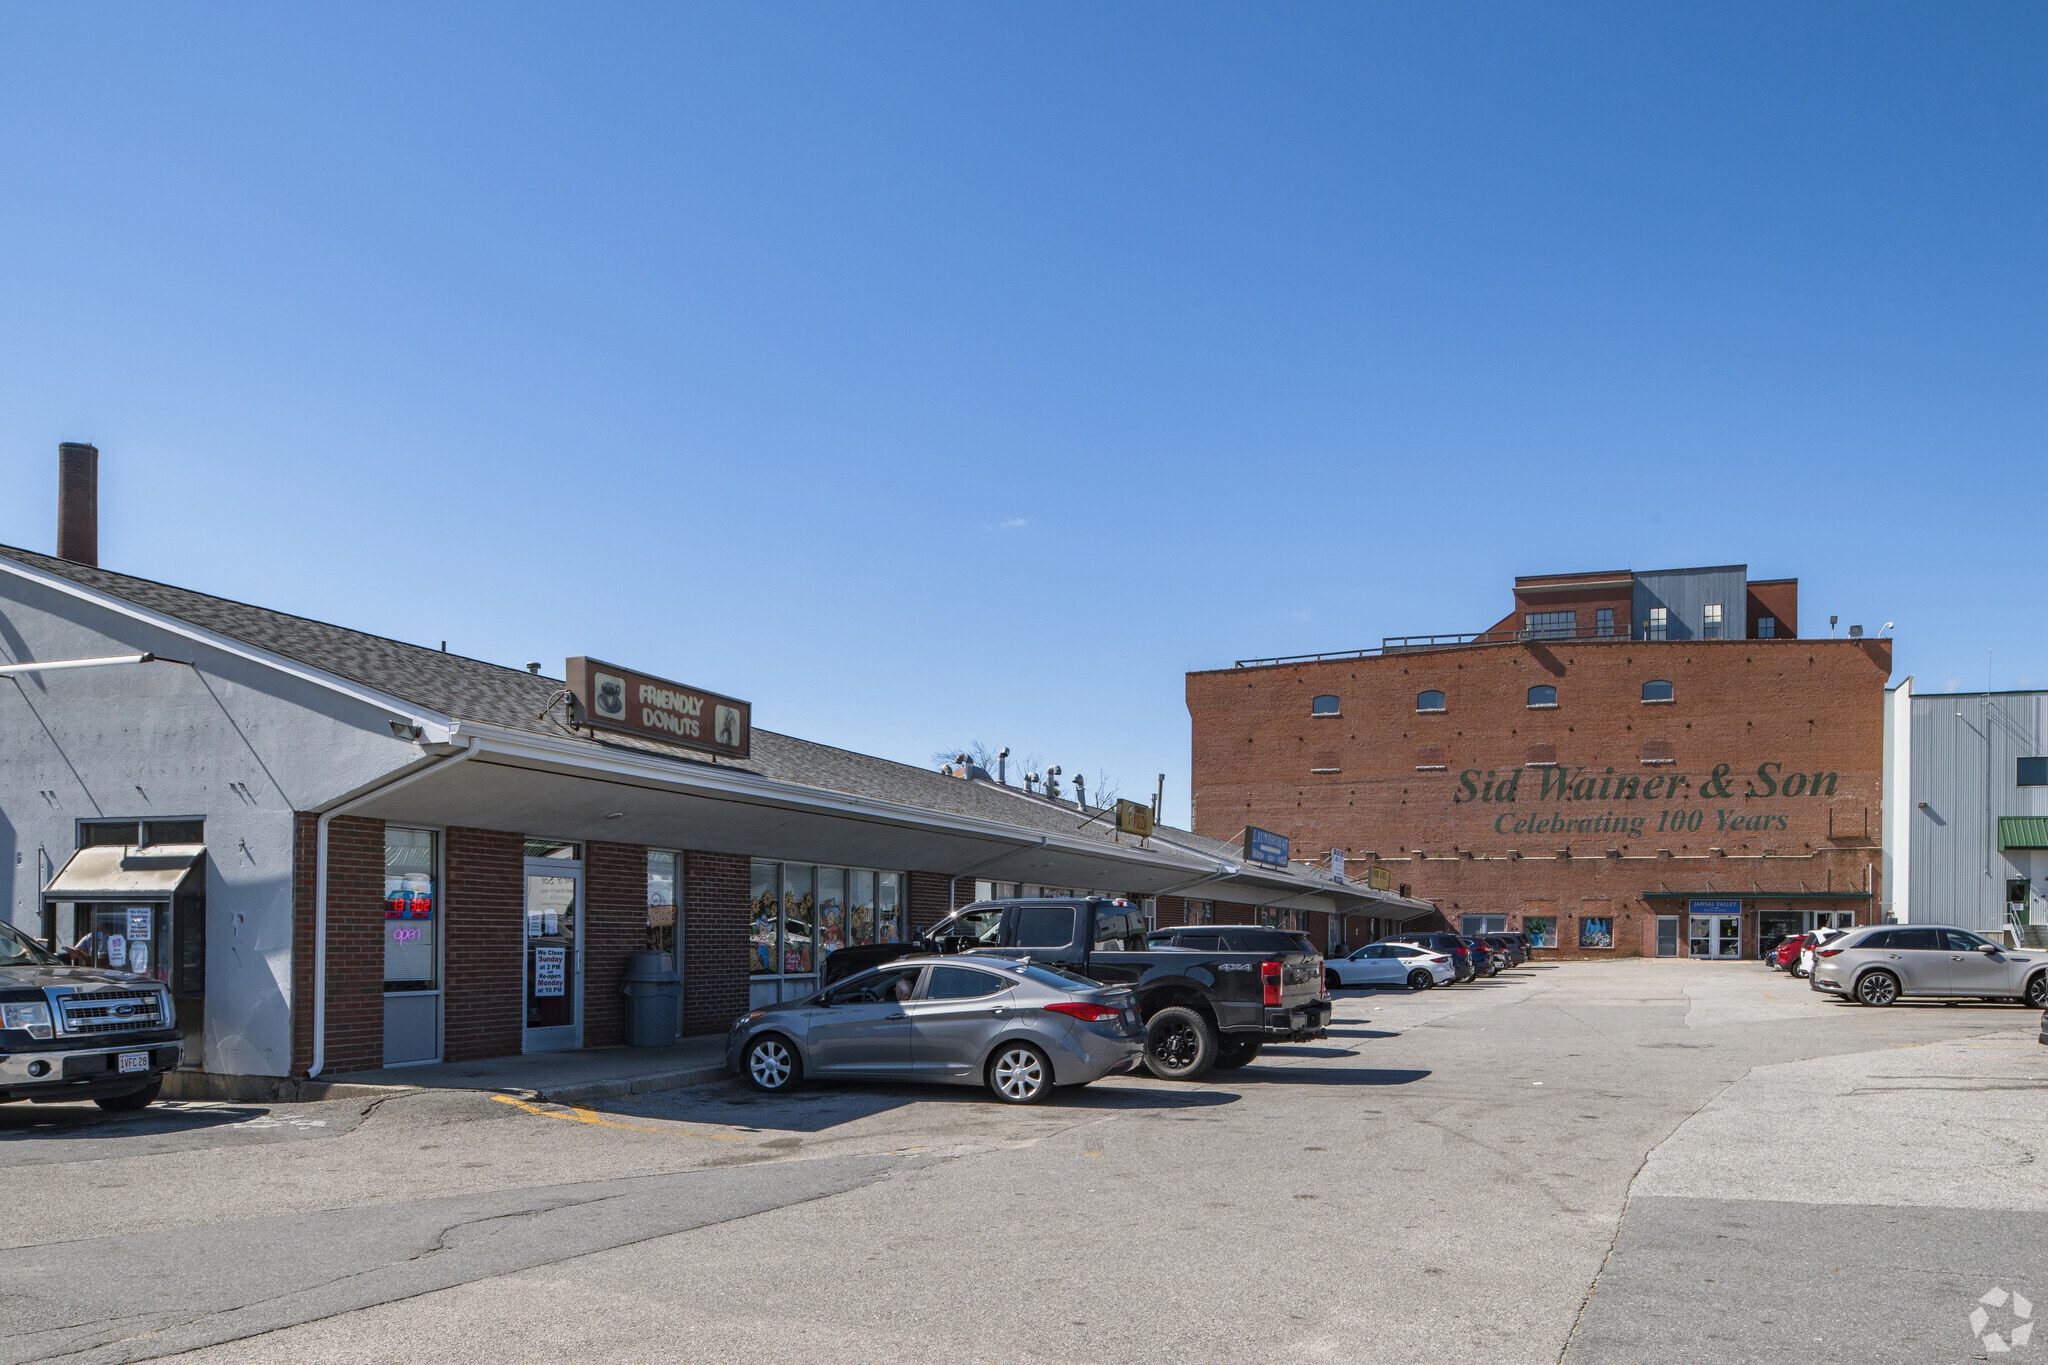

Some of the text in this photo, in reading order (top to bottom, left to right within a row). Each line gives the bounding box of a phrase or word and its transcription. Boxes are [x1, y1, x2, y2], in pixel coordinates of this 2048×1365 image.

[639, 684, 704, 716] FRIENDLY
[642, 707, 700, 737] DONUTS
[1453, 761, 1838, 803] Sid Wainer & Son
[1494, 808, 1789, 839] Celebrating 100 Years
[1252, 829, 1288, 851] LAUNDROMAT
[410, 898, 431, 912] 302
[393, 928, 421, 946] open
[120, 1056, 147, 1069] 1VFC 28
